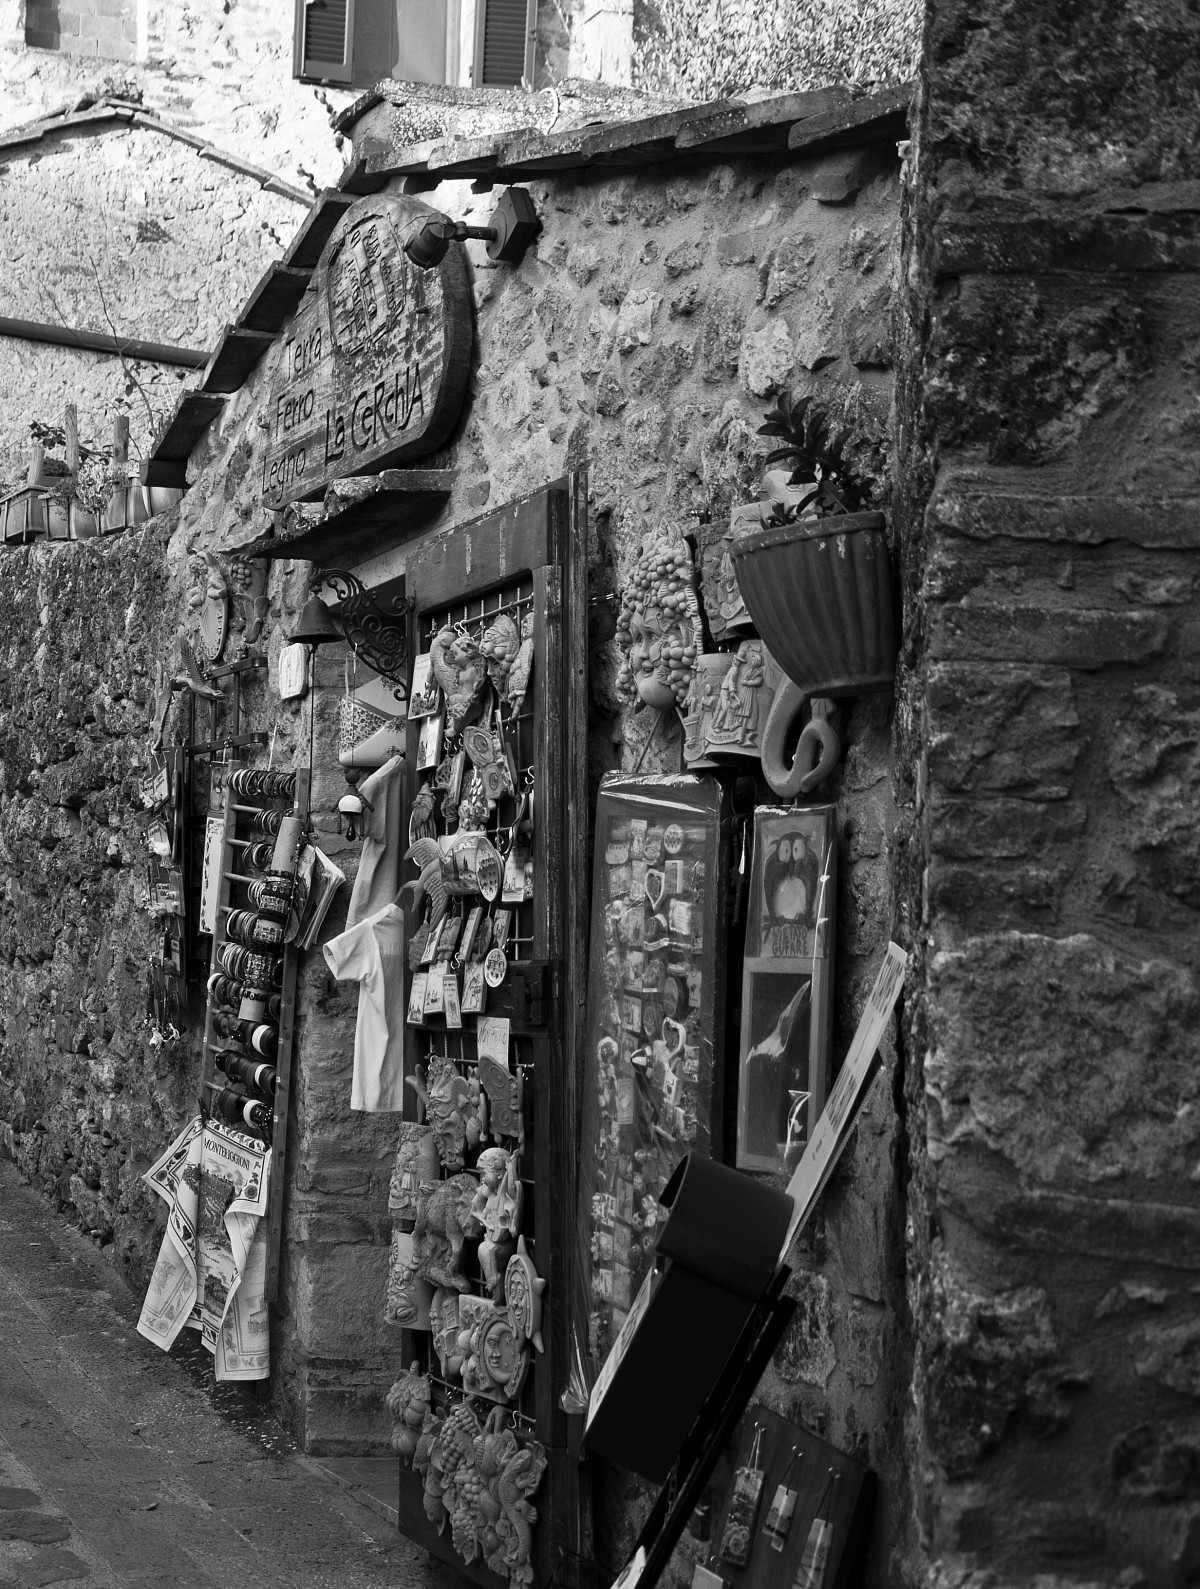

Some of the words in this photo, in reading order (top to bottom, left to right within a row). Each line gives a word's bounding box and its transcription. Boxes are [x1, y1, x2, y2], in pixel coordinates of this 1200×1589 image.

[284, 326, 323, 382] Terra
[275, 389, 314, 440] Ferro
[325, 408, 345, 467] La
[261, 447, 307, 503] Legno
